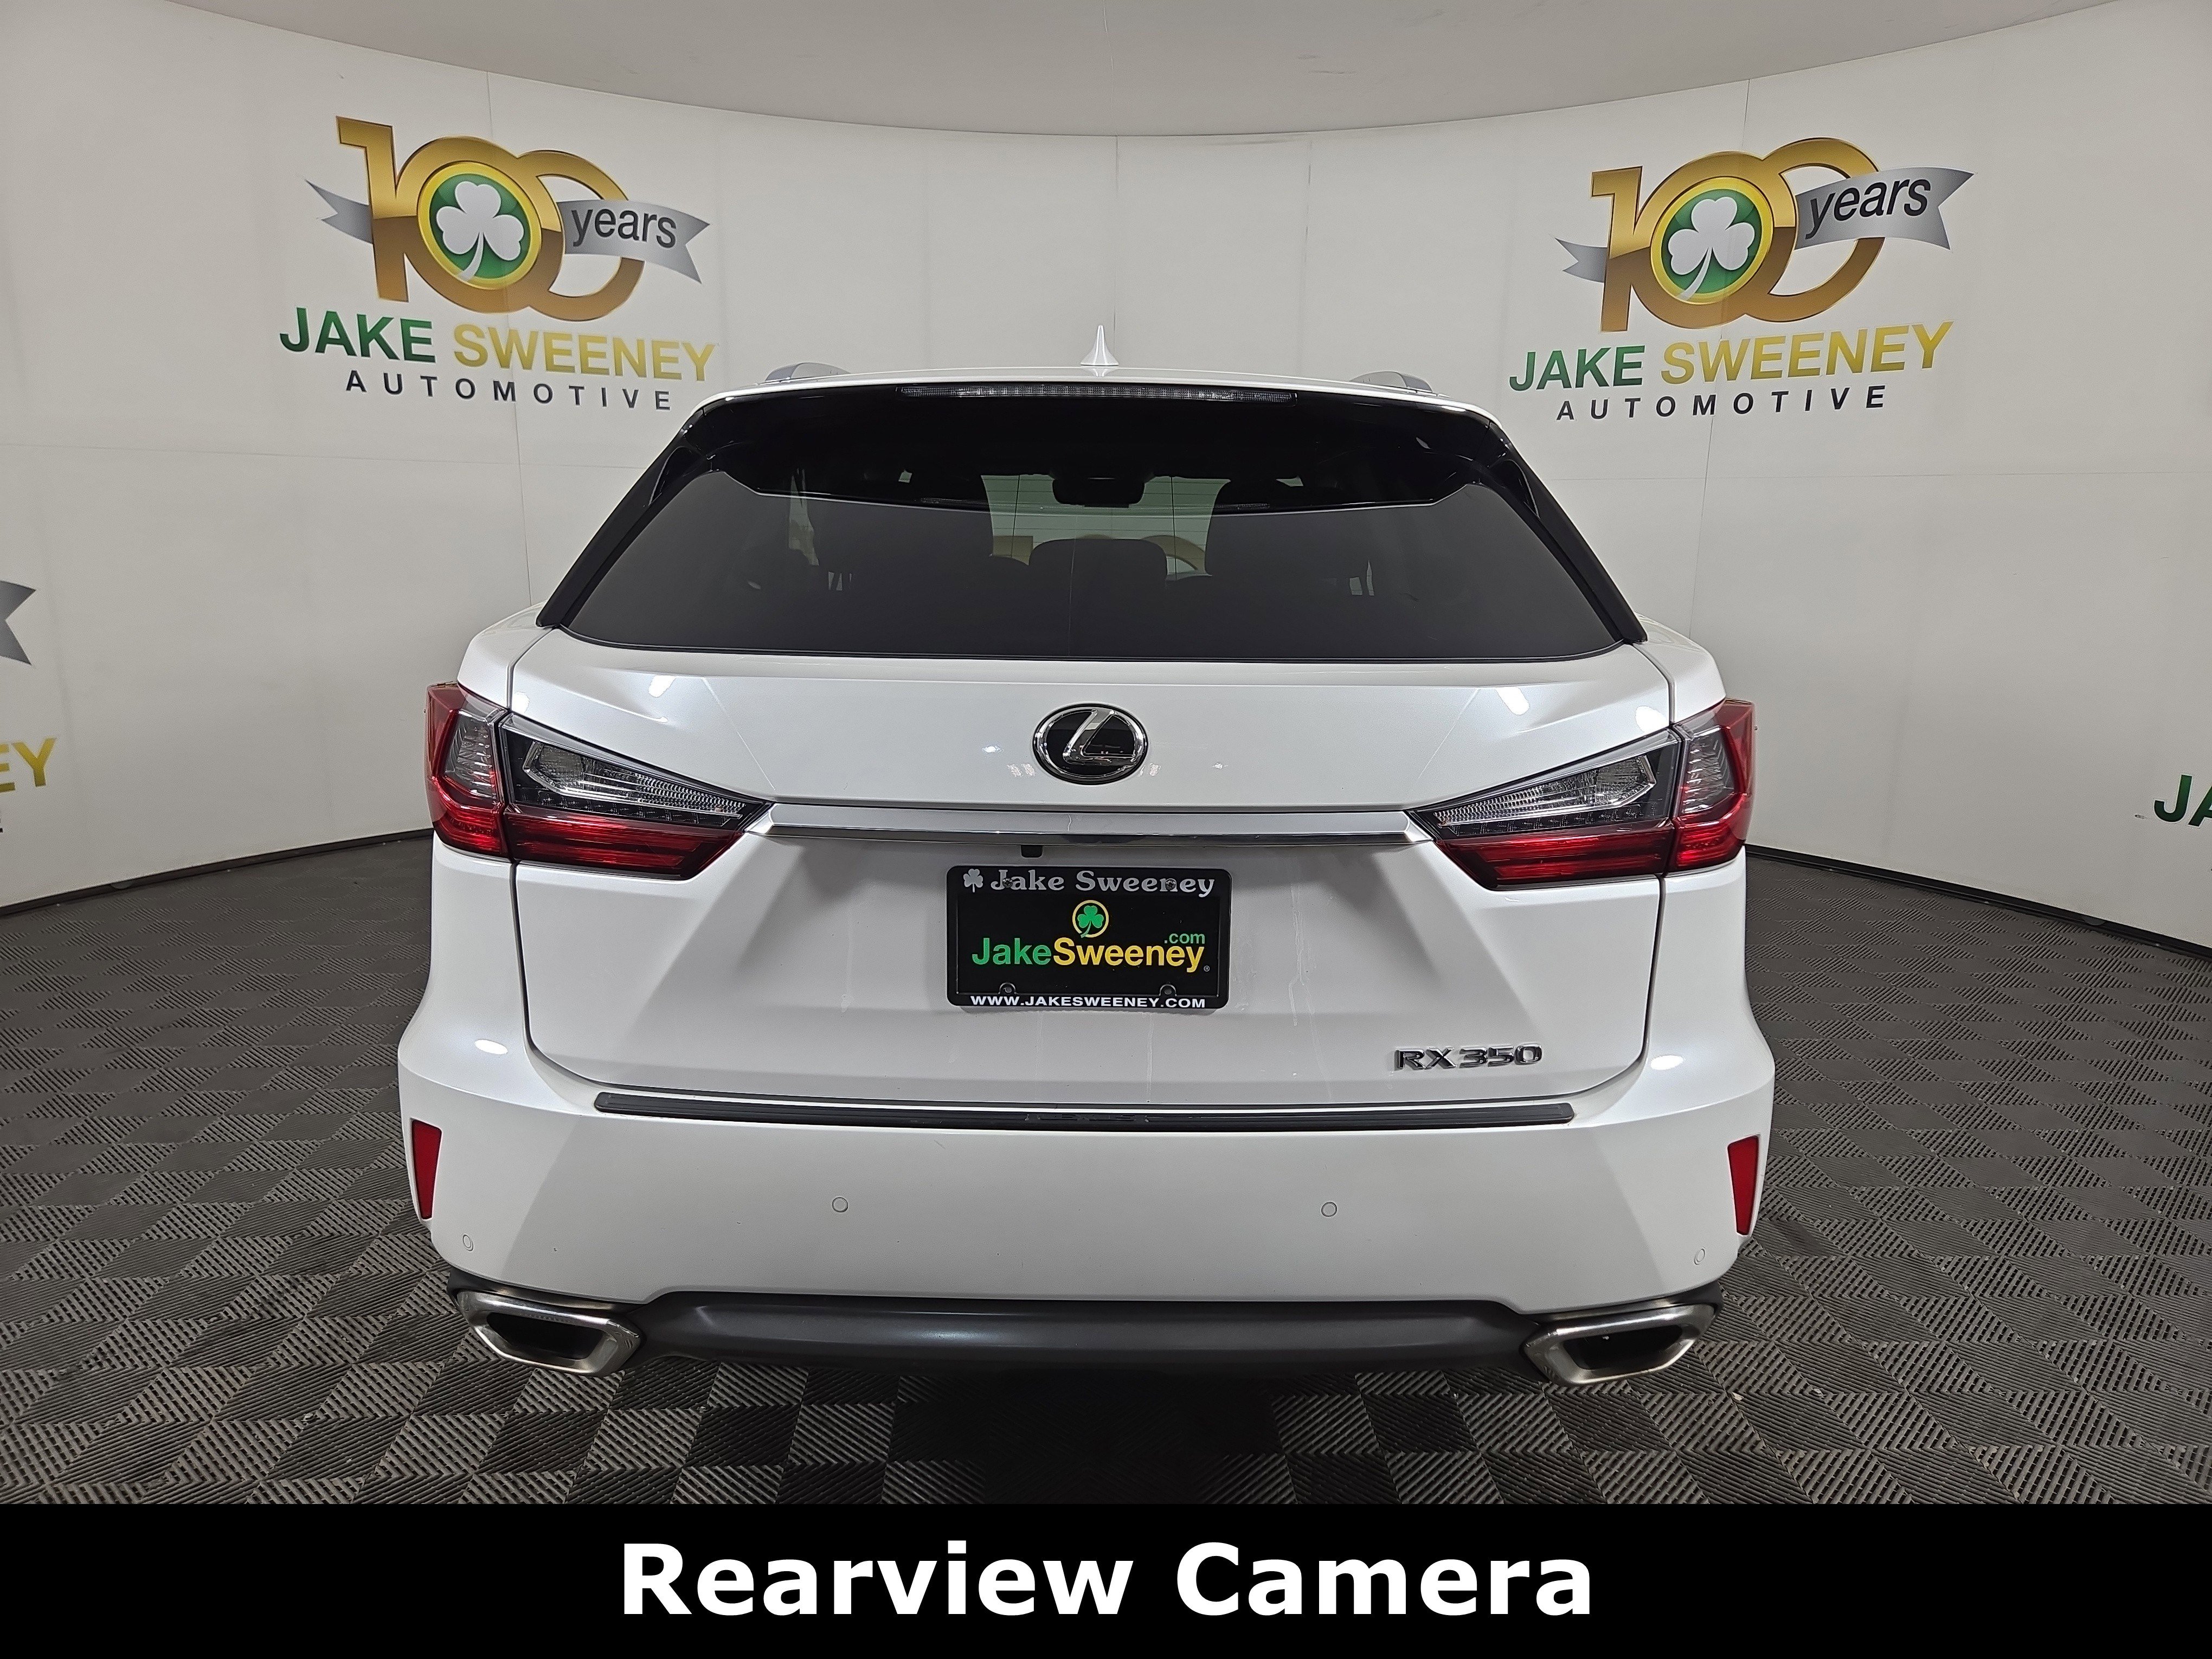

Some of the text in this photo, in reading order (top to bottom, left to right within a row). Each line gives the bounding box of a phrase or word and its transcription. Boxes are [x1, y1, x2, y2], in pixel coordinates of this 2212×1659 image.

[1805, 177, 1931, 239] years
[571, 208, 677, 249] years
[279, 307, 716, 382] JAKE SWEENEY
[1509, 321, 1954, 391] JAKE SWEENEY
[346, 369, 671, 410] AUTOMOTIVE
[1557, 385, 1886, 421] AUTOMOTIVE
[991, 870, 1215, 897] Jake Sweeney
[972, 937, 1205, 973] JakeSweeney
[1164, 933, 1206, 944] .com
[970, 995, 1206, 1008] WWW.JAKESWEENEY.COM
